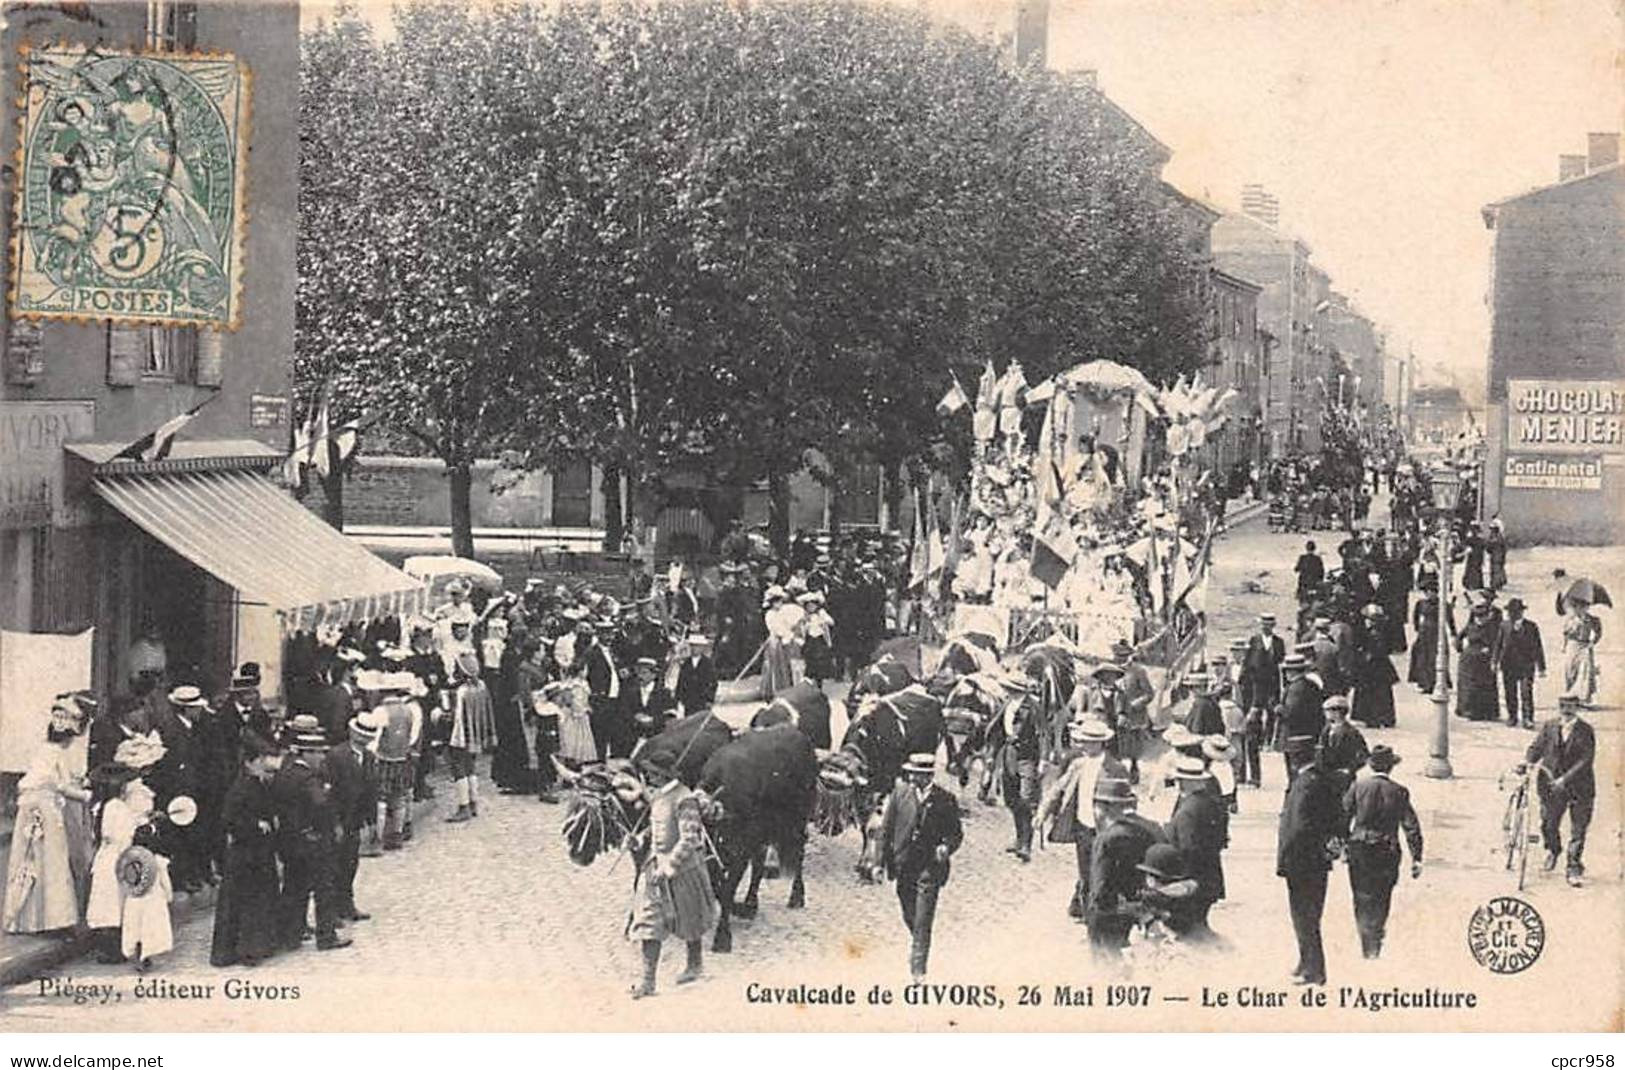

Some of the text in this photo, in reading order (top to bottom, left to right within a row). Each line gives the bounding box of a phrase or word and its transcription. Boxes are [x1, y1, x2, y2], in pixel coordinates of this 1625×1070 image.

[79, 289, 168, 312] POSTES
[1519, 416, 1623, 444] MENIER
[1506, 457, 1602, 477] Continental
[38, 977, 301, 1005] Piégay, éditeur Givors
[746, 983, 1477, 1012] Cavalcade de GIVORS, 26 Mai 1907 Le Char de l'Agriculture
